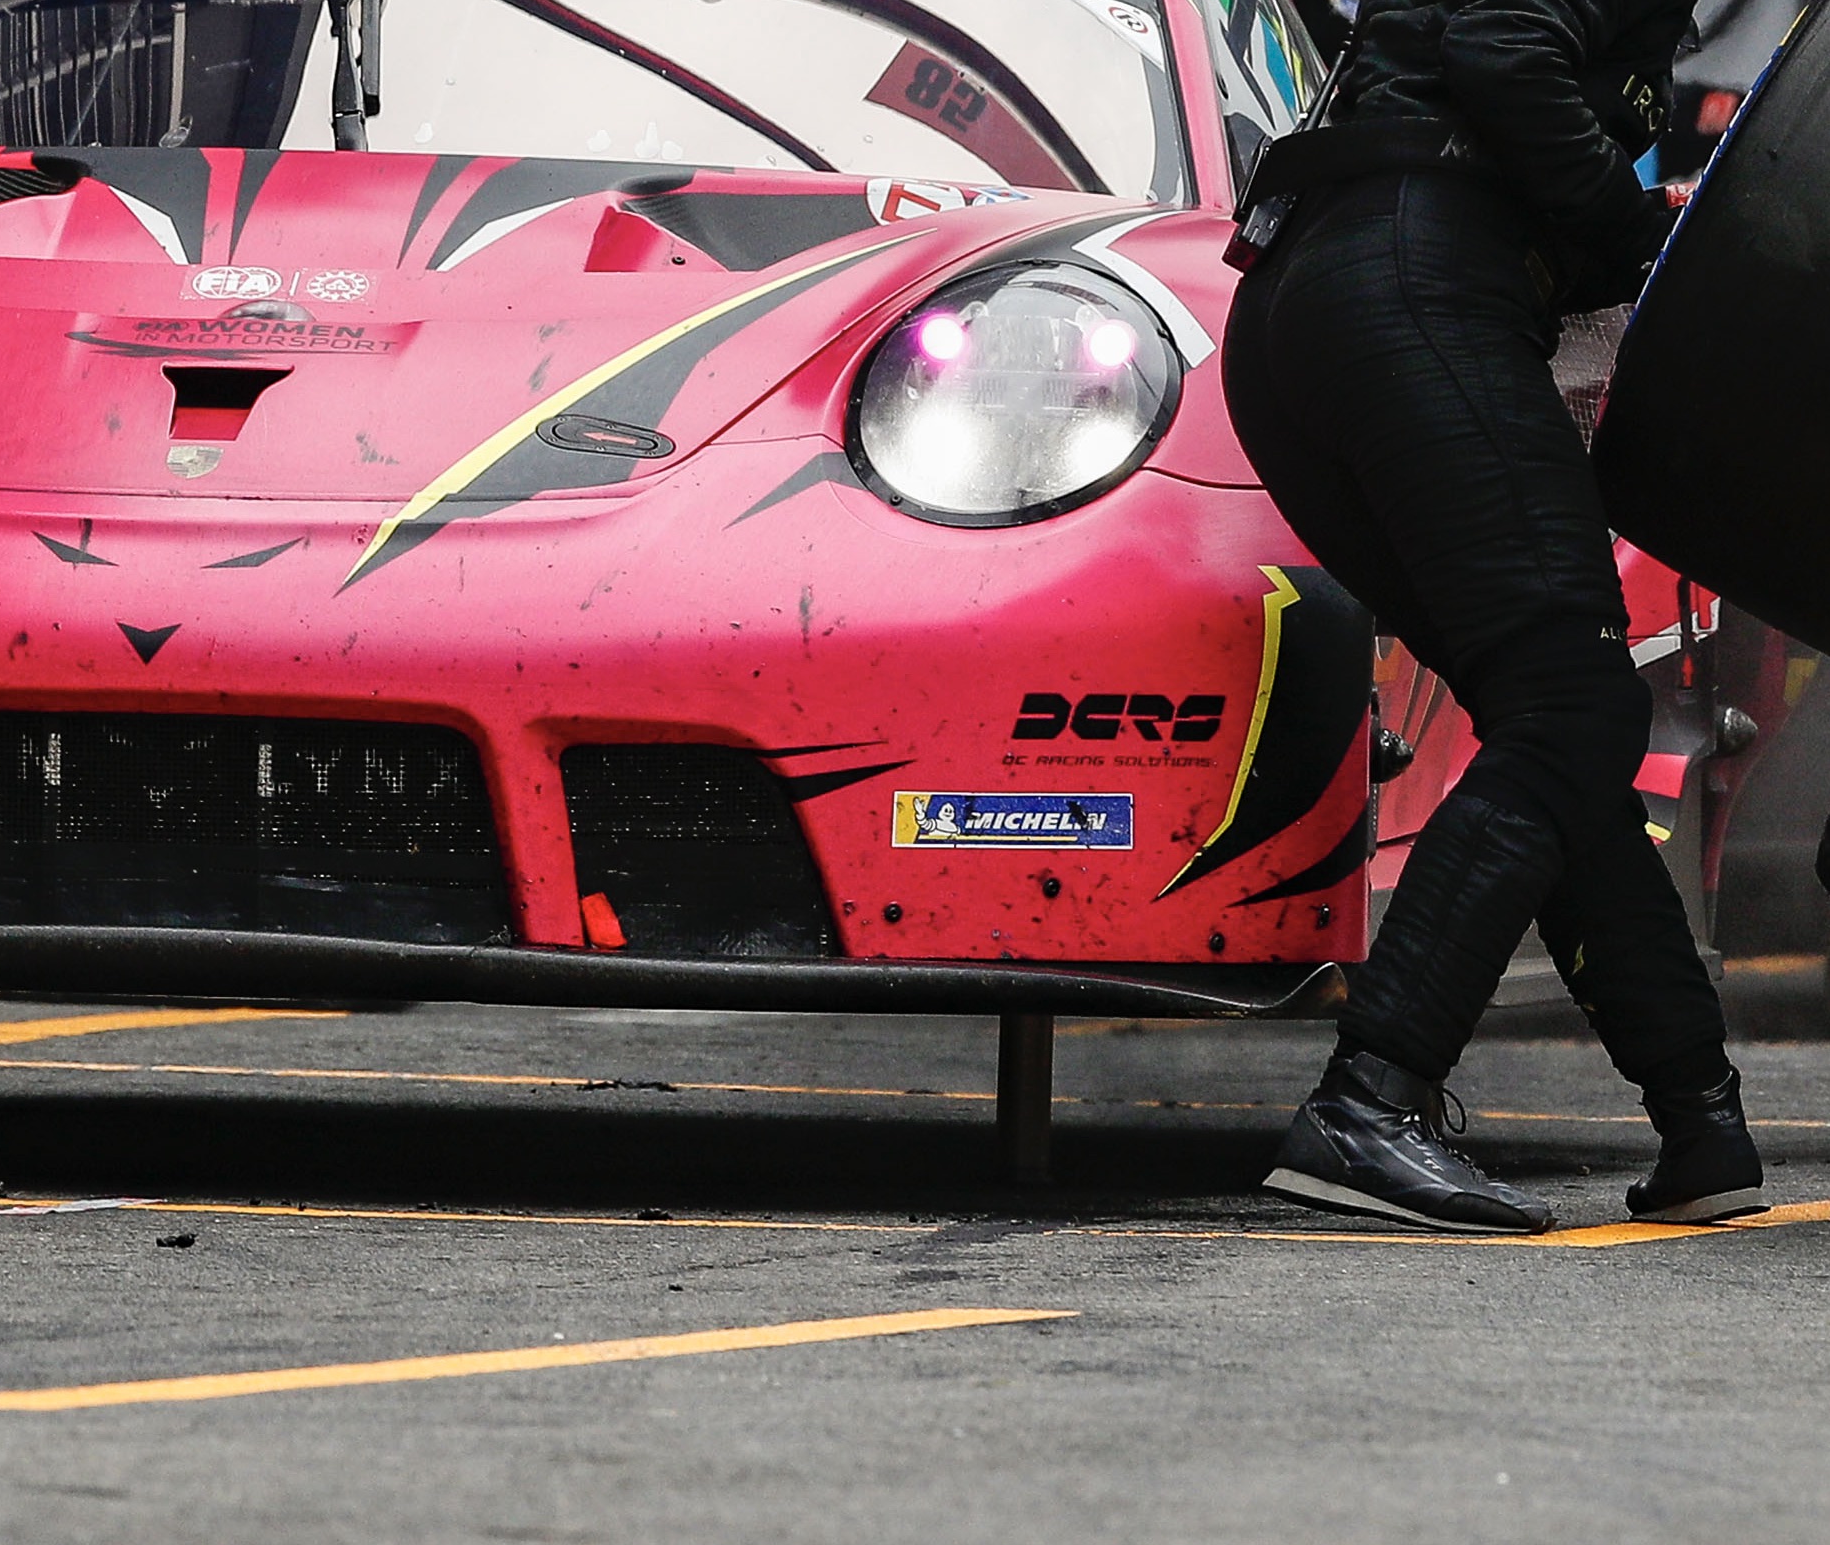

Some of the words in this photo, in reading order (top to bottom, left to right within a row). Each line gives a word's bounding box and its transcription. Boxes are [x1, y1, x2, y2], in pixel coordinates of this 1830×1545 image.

[198, 320, 366, 339] WOMEN
[163, 332, 399, 353] MOTORSPORT
[1036, 755, 1105, 768] RACING
